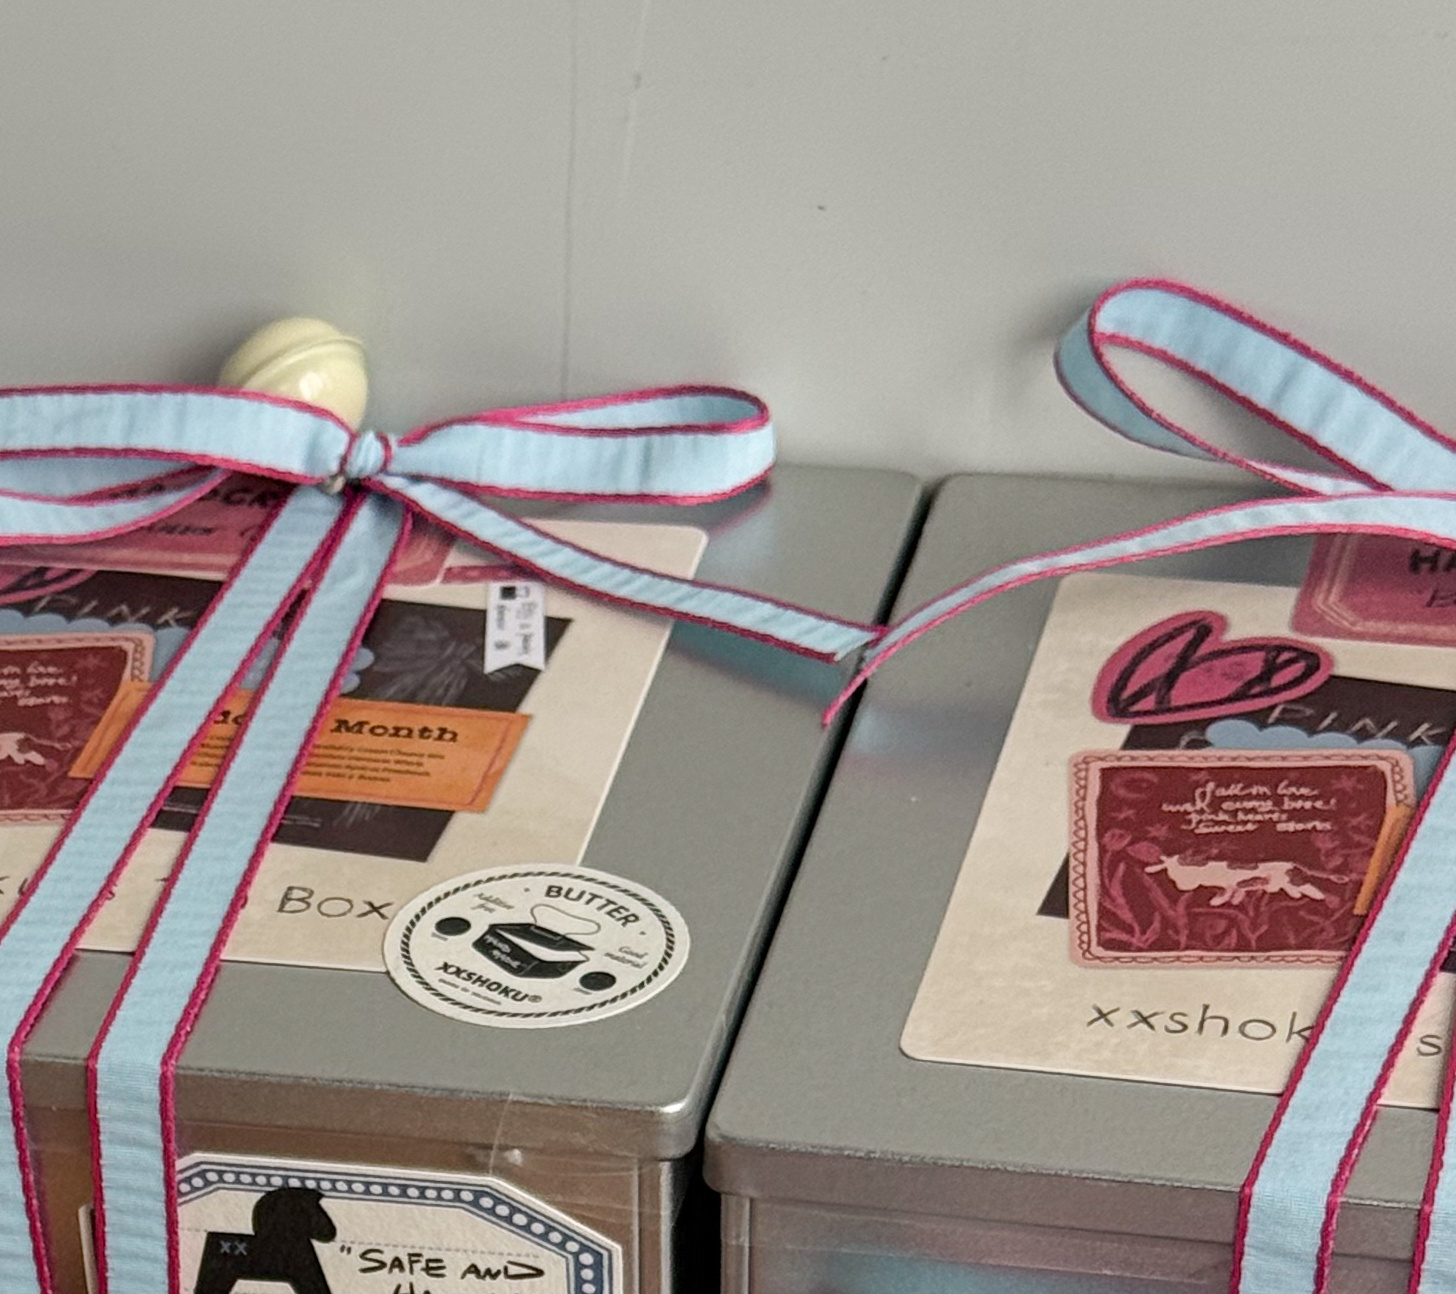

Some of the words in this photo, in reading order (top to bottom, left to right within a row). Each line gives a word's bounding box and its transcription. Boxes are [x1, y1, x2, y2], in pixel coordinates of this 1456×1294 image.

[330, 718, 459, 743] Month
[1267, 704, 1447, 746] PINK
[276, 885, 393, 922] Box
[544, 884, 640, 929] BUTTER
